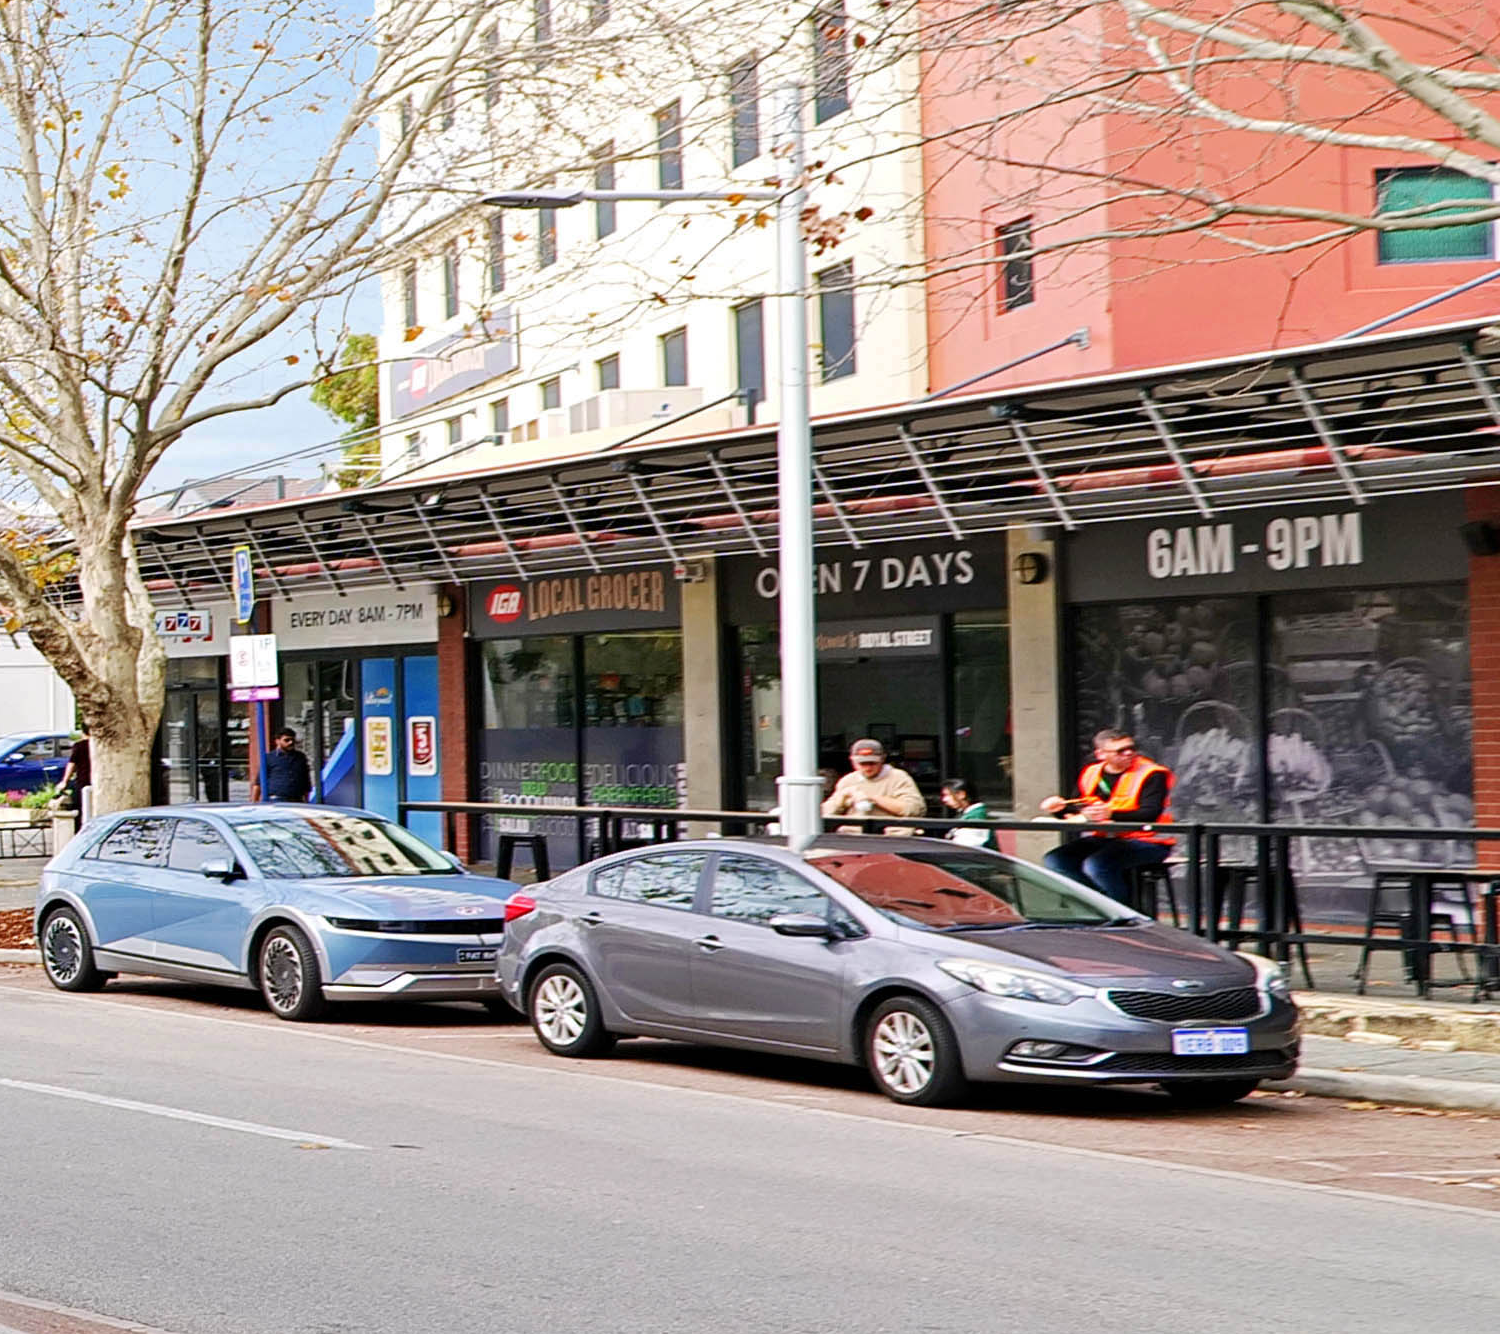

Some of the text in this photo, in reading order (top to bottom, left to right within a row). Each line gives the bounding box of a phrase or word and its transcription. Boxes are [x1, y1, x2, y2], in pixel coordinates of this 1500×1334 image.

[1147, 512, 1362, 579] 6AM - 9PM
[489, 570, 665, 622] IGA LOCAL GROCER
[756, 550, 974, 599] ON 7 DAYS
[290, 610, 326, 628] EVERY
[328, 609, 353, 626] DAY
[358, 606, 385, 623] 8AM
[396, 603, 423, 620] 7PM
[859, 631, 892, 649] ROYAL
[892, 629, 933, 647] STREET
